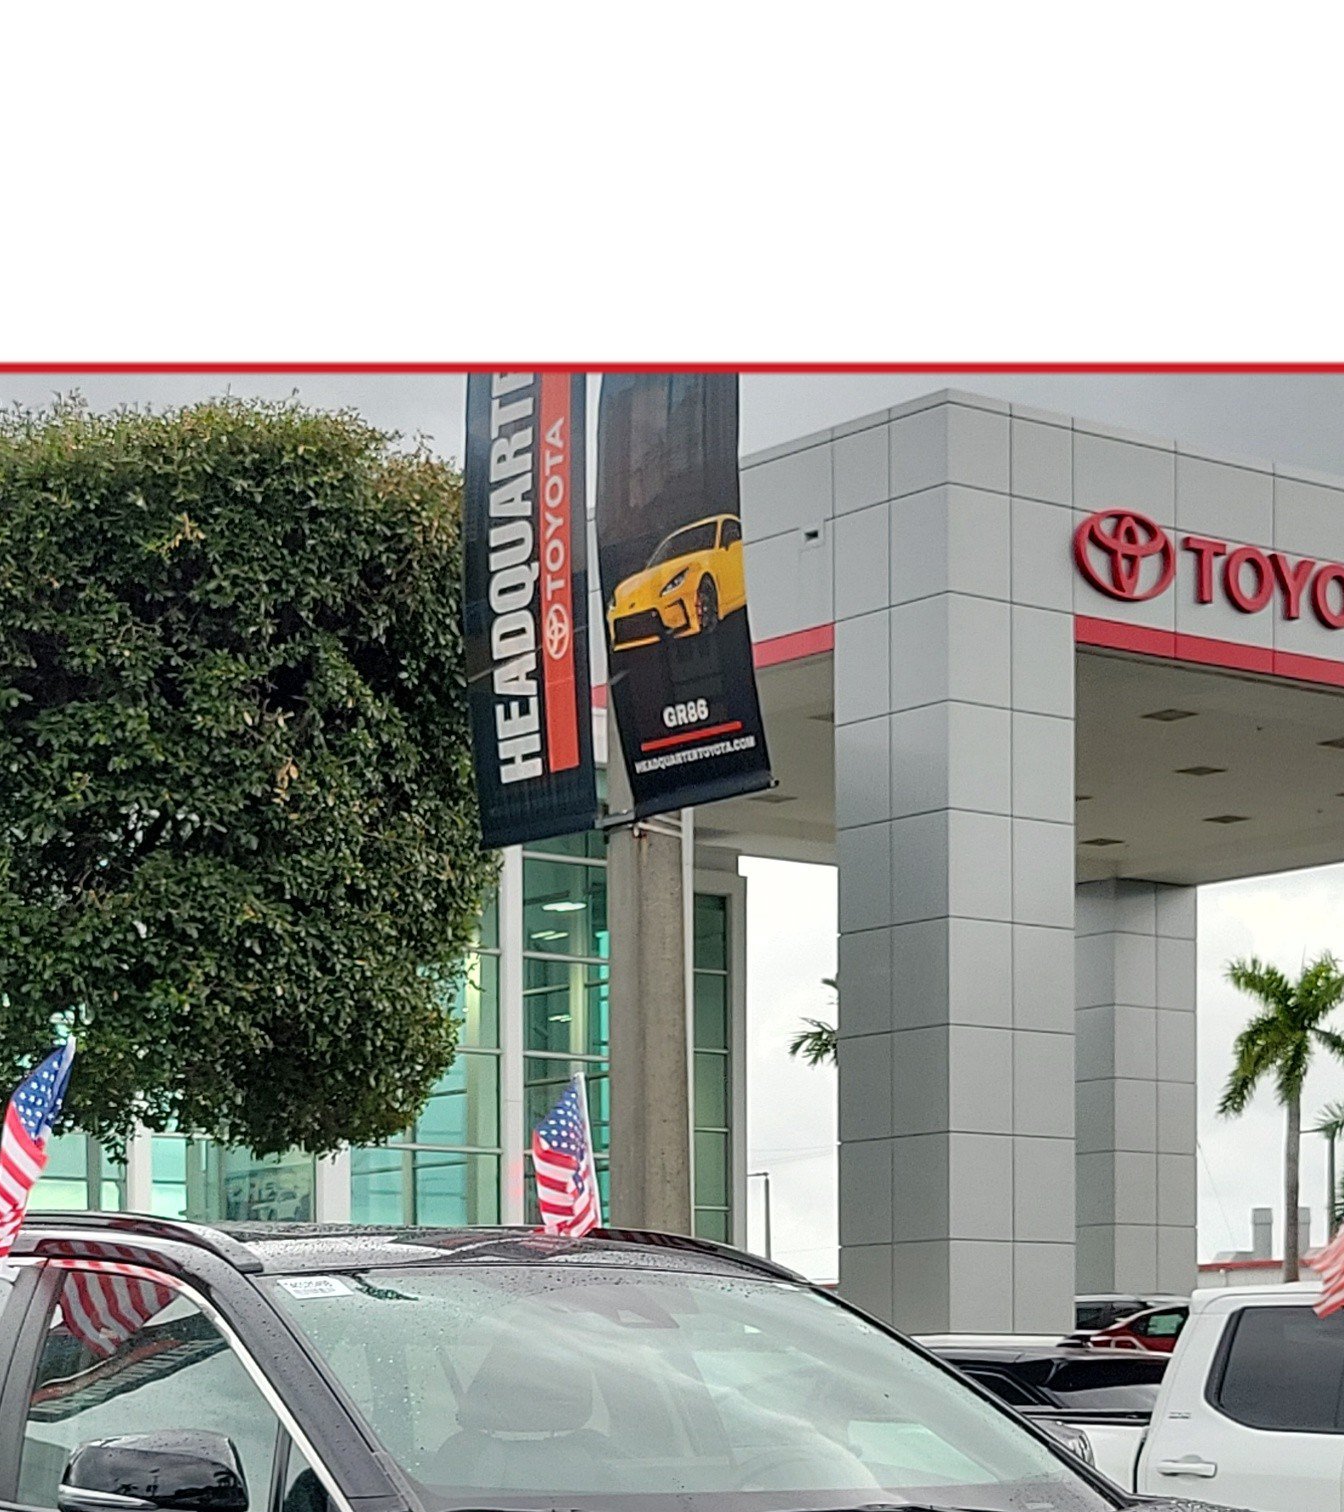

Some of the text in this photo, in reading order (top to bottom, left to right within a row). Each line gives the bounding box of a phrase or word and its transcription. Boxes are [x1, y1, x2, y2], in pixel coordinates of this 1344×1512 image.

[544, 416, 566, 600] TOYOTA
[662, 698, 710, 728] GR86
[635, 735, 756, 774] HEADQUARTERTOYOTA.COM
